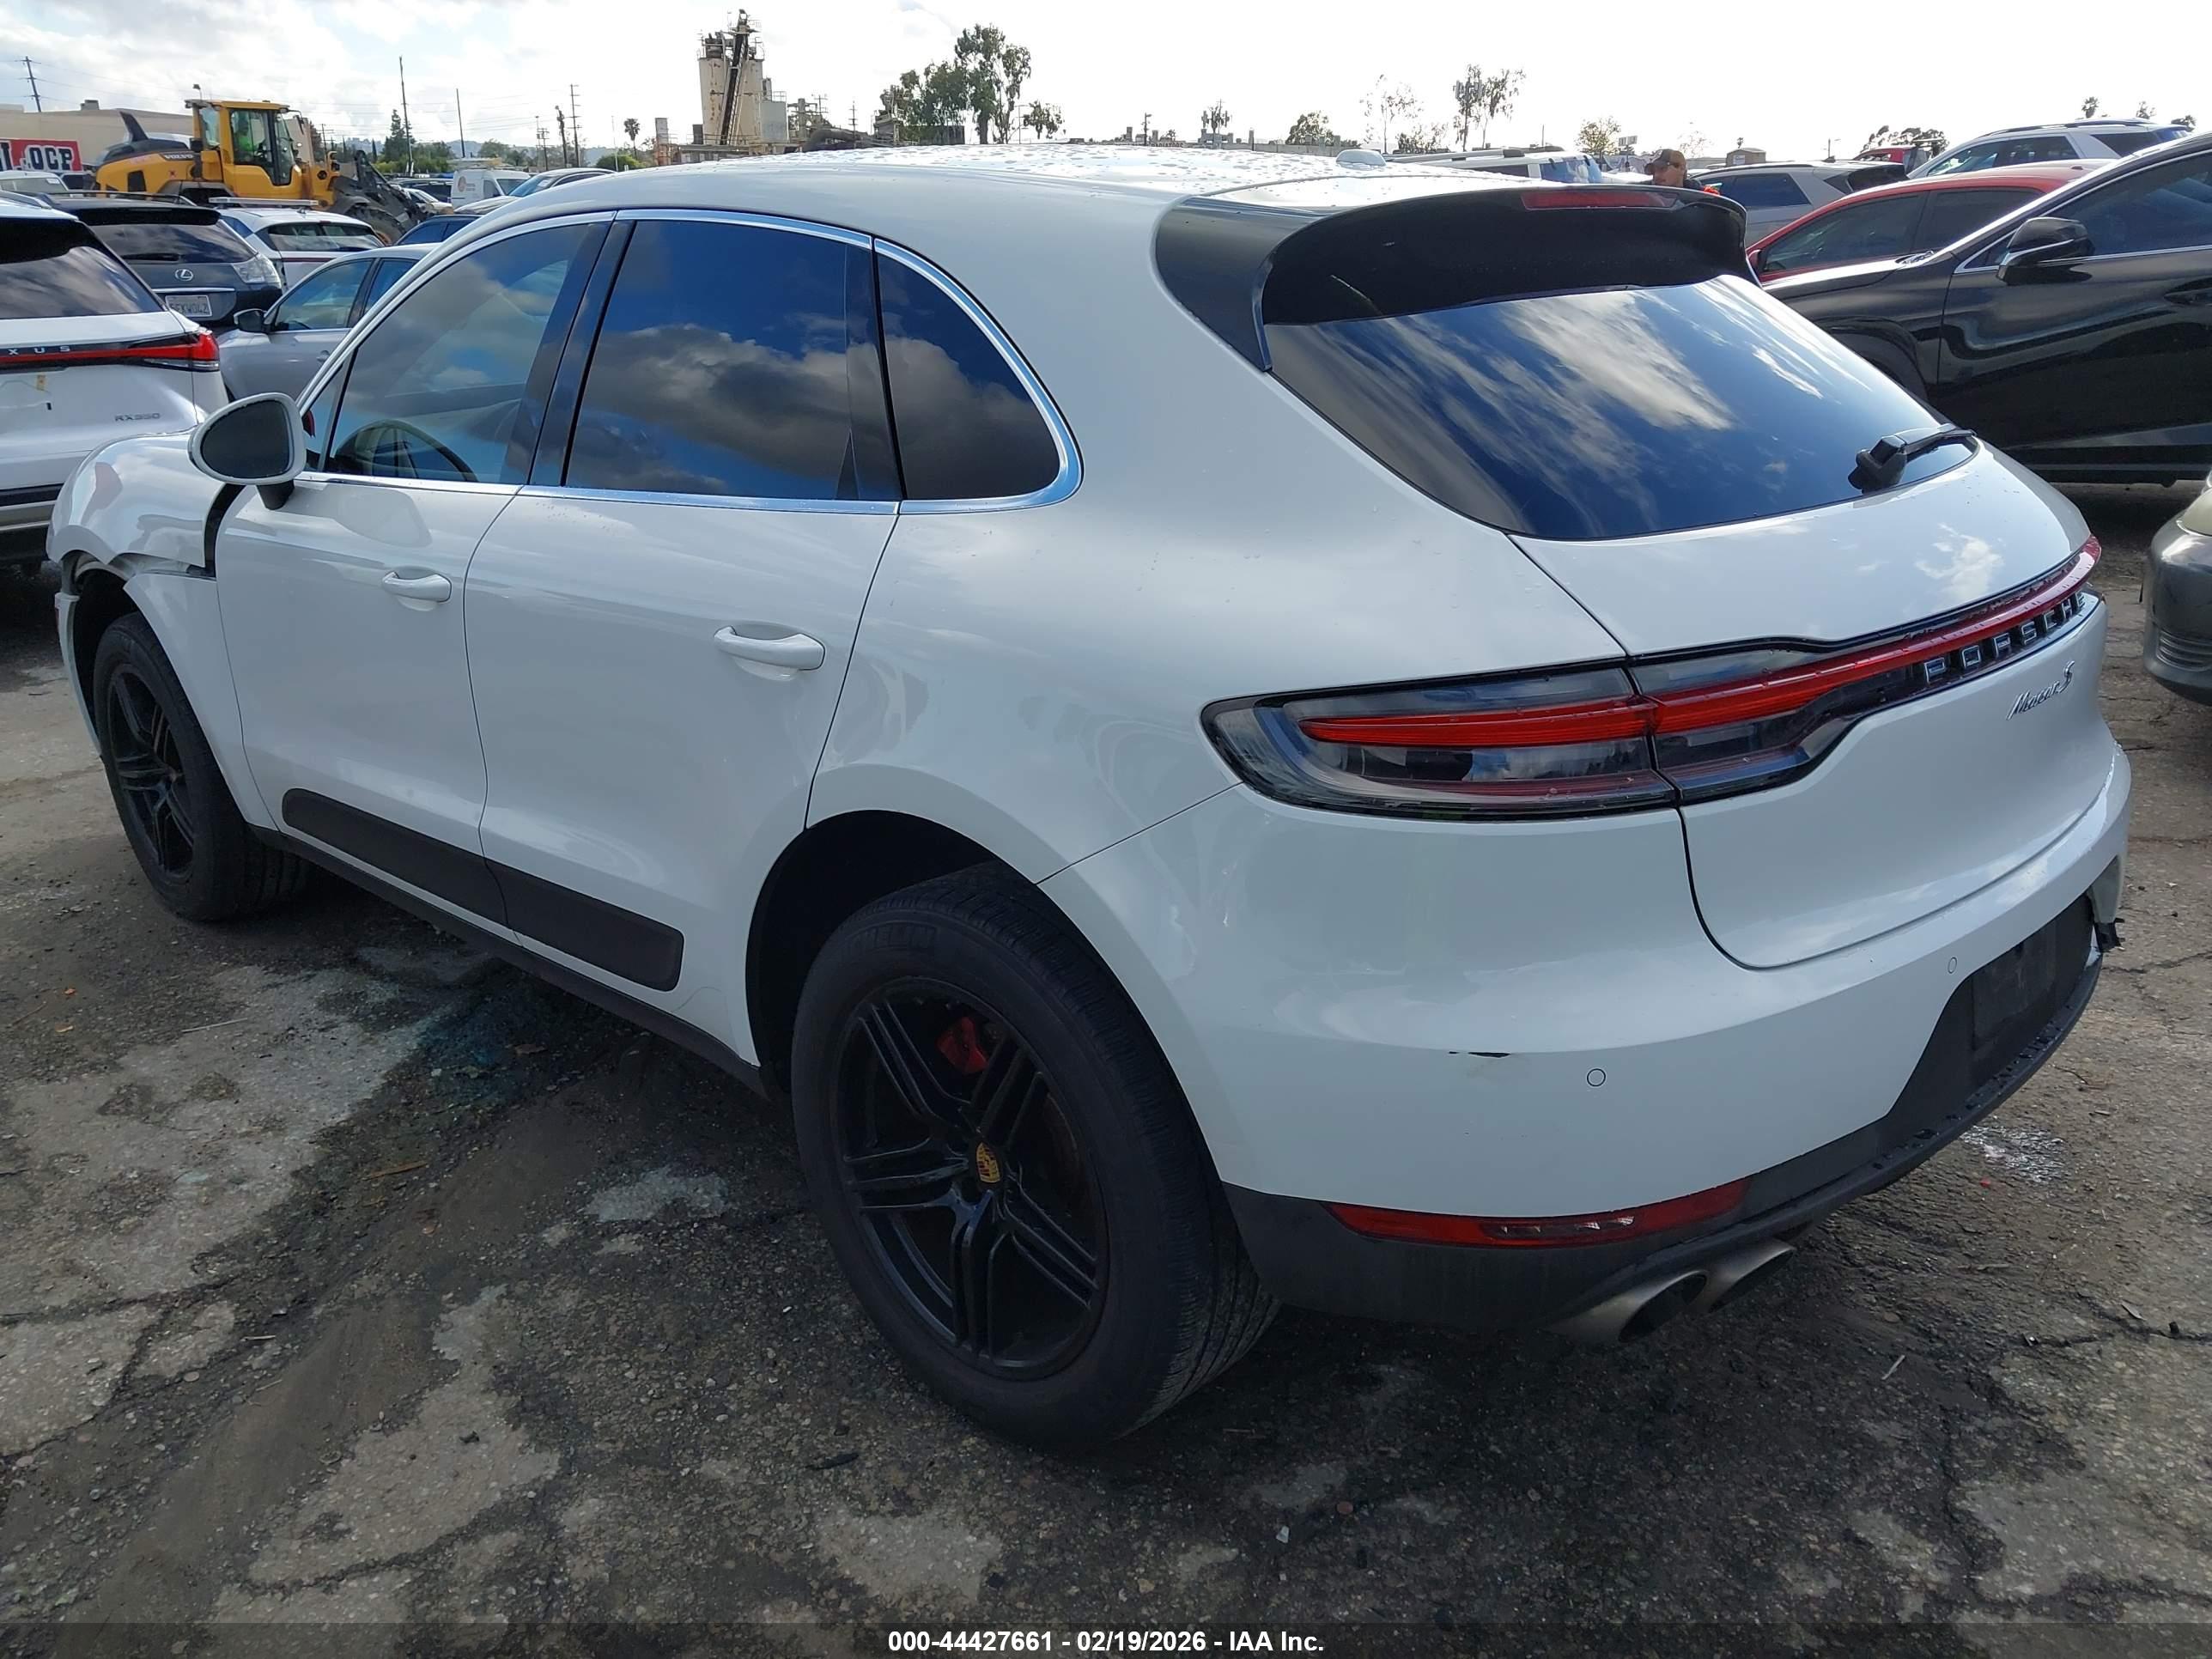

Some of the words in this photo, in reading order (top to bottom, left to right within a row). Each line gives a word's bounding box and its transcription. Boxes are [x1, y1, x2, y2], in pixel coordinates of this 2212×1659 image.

[29, 147, 72, 171] OCP
[1923, 592, 2086, 684] PORSCHE
[2006, 679, 2059, 721] Macan
[2057, 660, 2075, 693] S
